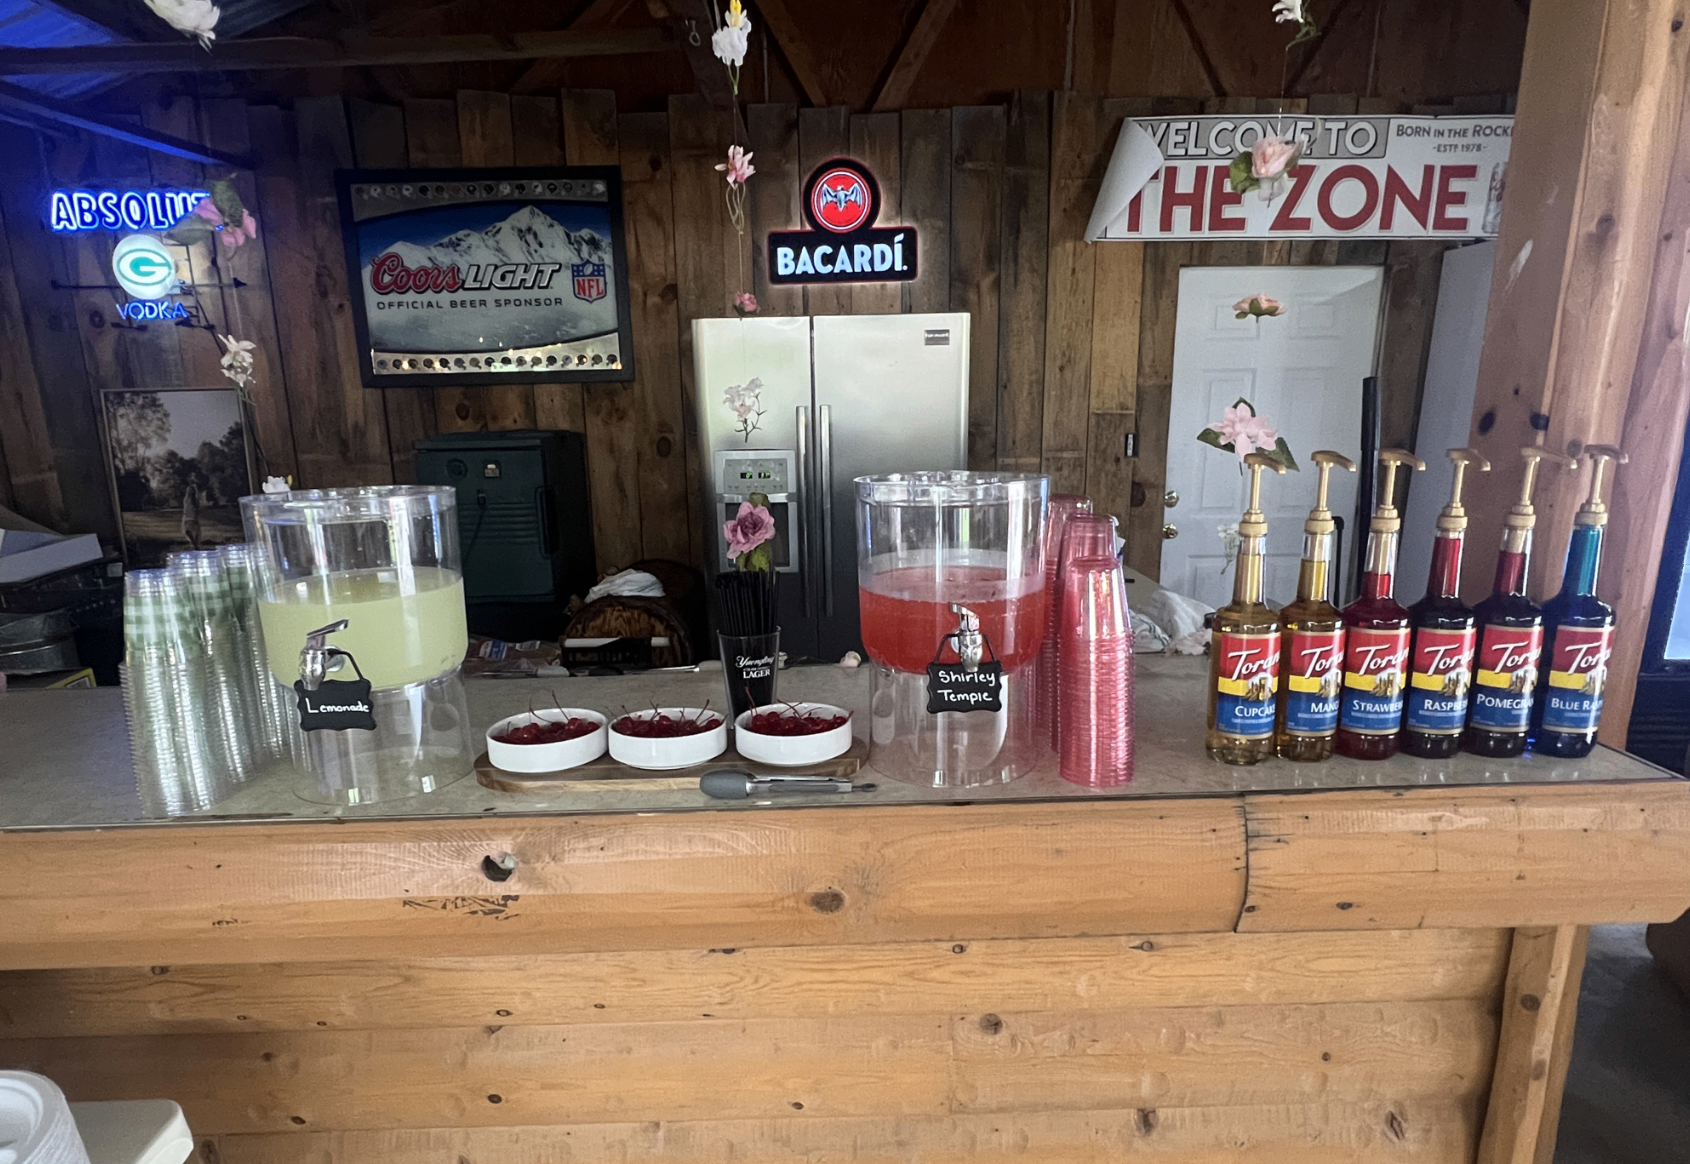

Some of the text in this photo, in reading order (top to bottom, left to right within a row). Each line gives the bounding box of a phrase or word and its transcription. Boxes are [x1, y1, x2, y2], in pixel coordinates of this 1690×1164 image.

[1325, 120, 1378, 156] TO
[1396, 124, 1431, 138] BORN
[1433, 128, 1445, 138] IN
[1447, 128, 1469, 138] THE
[1268, 163, 1479, 232] ZONE
[371, 252, 562, 295] Coors LIGHT
[576, 278, 604, 298] NFL
[116, 301, 188, 320] VODKA
[377, 298, 563, 310] OFFICIAL BEER SPONSOR
[743, 668, 770, 678] LAGER
[938, 670, 996, 687] Shirley
[305, 697, 370, 713] Lemonade
[937, 689, 993, 705] Temple
[1551, 697, 1580, 711] BLUE
